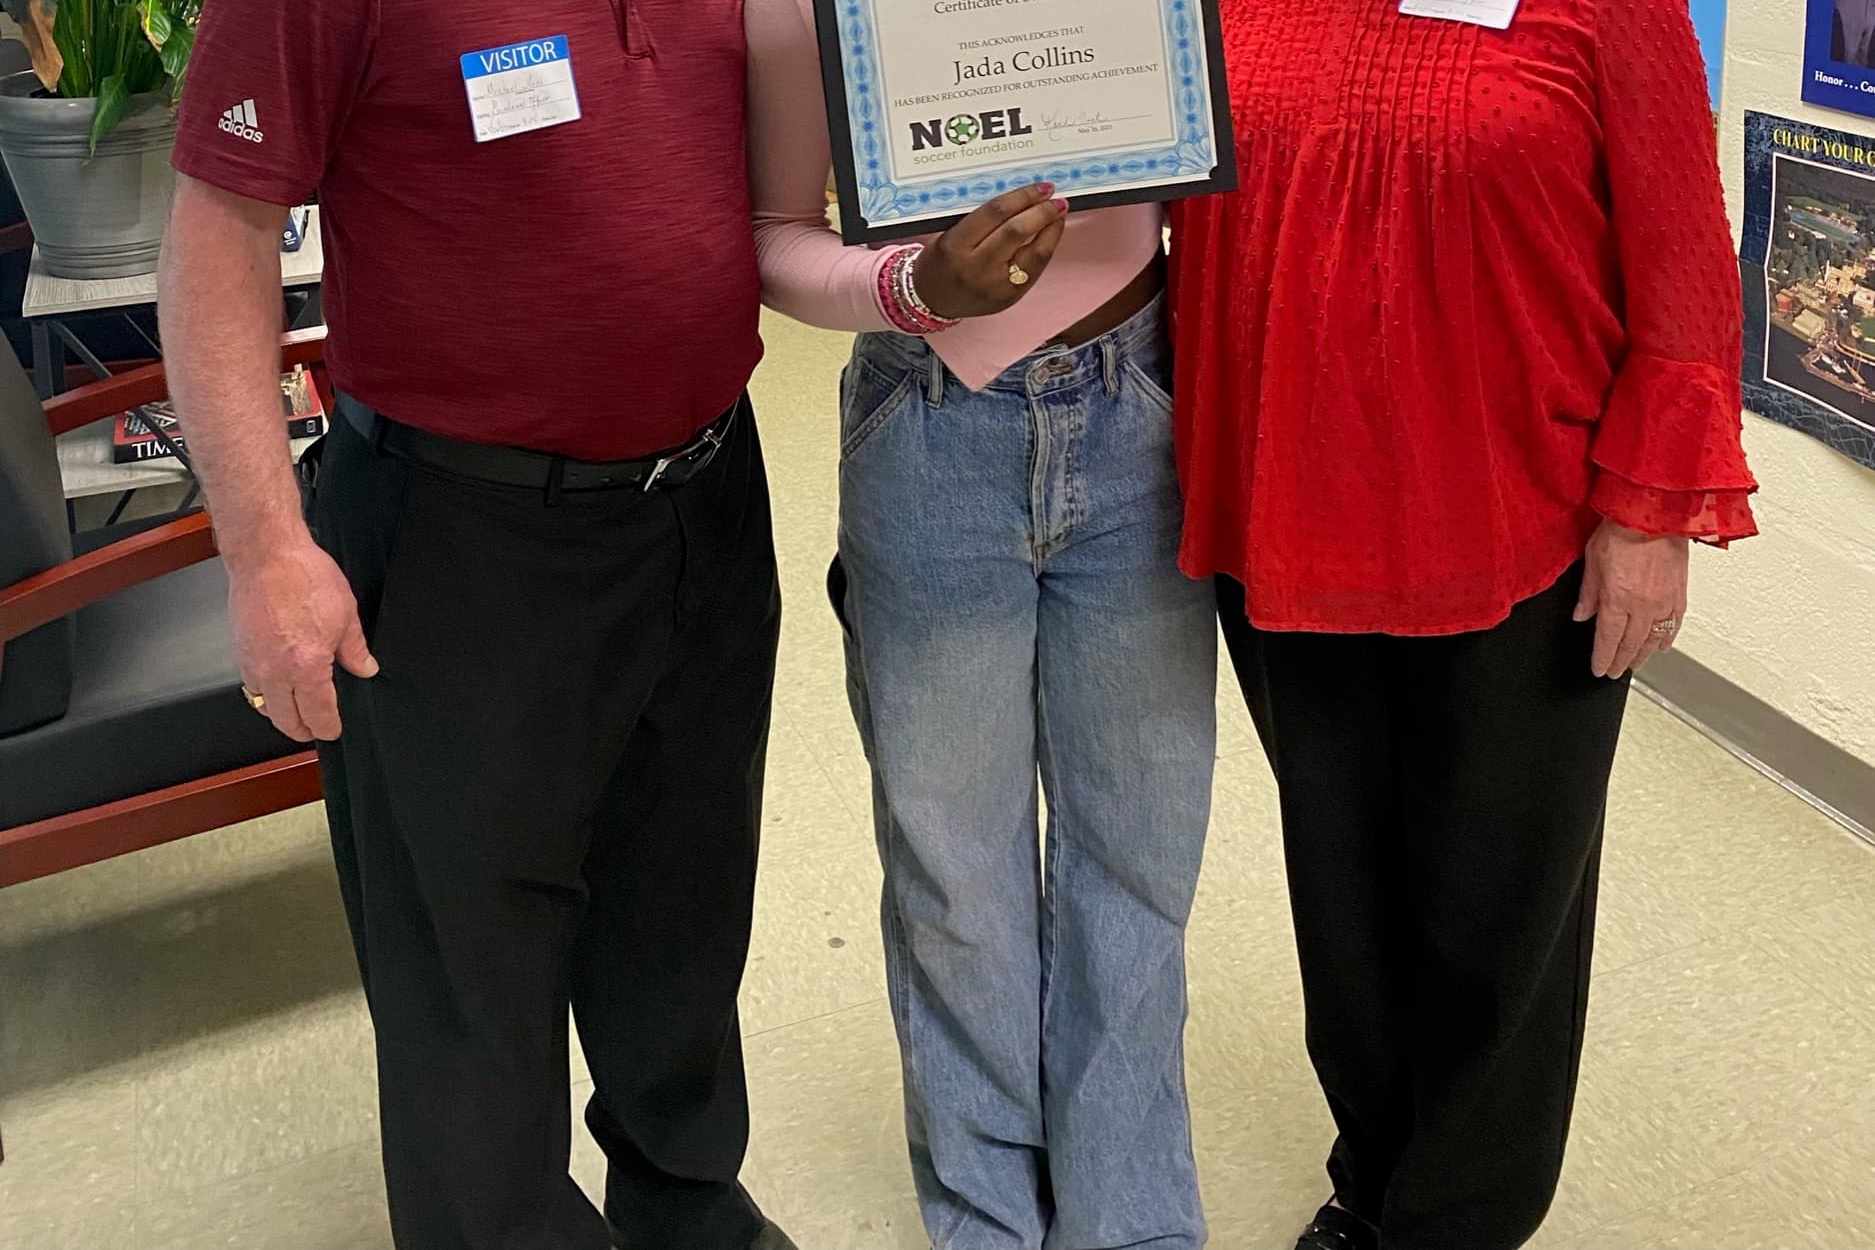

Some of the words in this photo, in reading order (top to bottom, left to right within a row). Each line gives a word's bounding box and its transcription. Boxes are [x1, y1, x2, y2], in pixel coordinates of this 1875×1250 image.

[958, 40, 981, 50] THIS
[981, 29, 1060, 48] ACKNOWLEDGES
[1060, 26, 1085, 38] THAT
[480, 41, 558, 73] VISITOR
[953, 57, 1005, 85] Jada
[1012, 47, 1095, 72] Collins
[894, 96, 914, 108] HAS
[915, 93, 940, 105] BEEN
[941, 84, 1002, 102] RECOGNIZED
[1003, 81, 1022, 92] FOR
[1022, 72, 1090, 90] OUTSTANDING
[1091, 63, 1159, 80] ACHIEVEMENT
[218, 118, 264, 143] adidas
[909, 107, 1033, 151] NOEL
[913, 151, 956, 165] soccer
[960, 139, 1034, 159] foundation
[1773, 128, 1820, 154] CHART
[1822, 140, 1863, 165] YOUR
